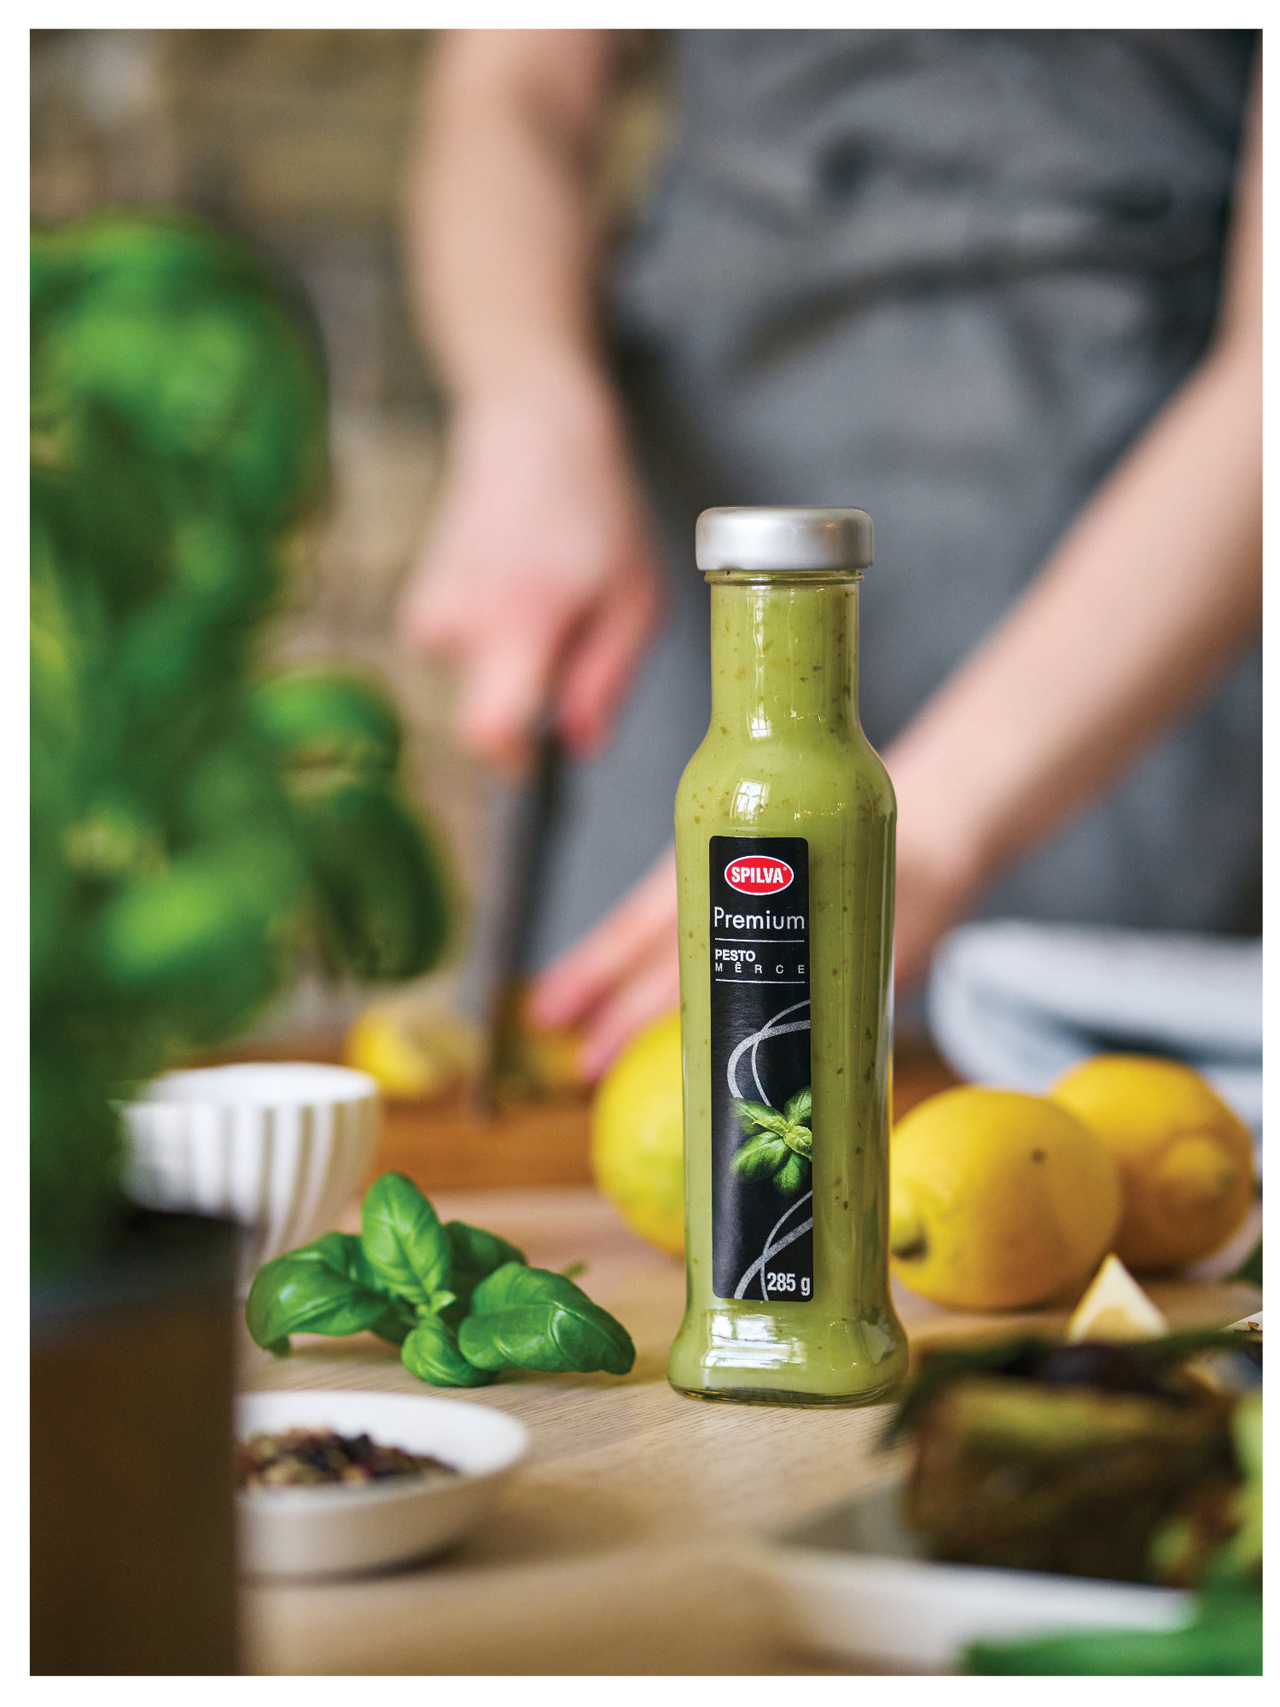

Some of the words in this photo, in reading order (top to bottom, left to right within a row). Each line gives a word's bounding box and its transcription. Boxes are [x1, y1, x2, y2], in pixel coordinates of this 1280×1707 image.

[714, 906, 805, 930] Premium
[715, 948, 756, 962] PESTO
[767, 1272, 797, 1292] 285
[801, 1277, 811, 1296] g
